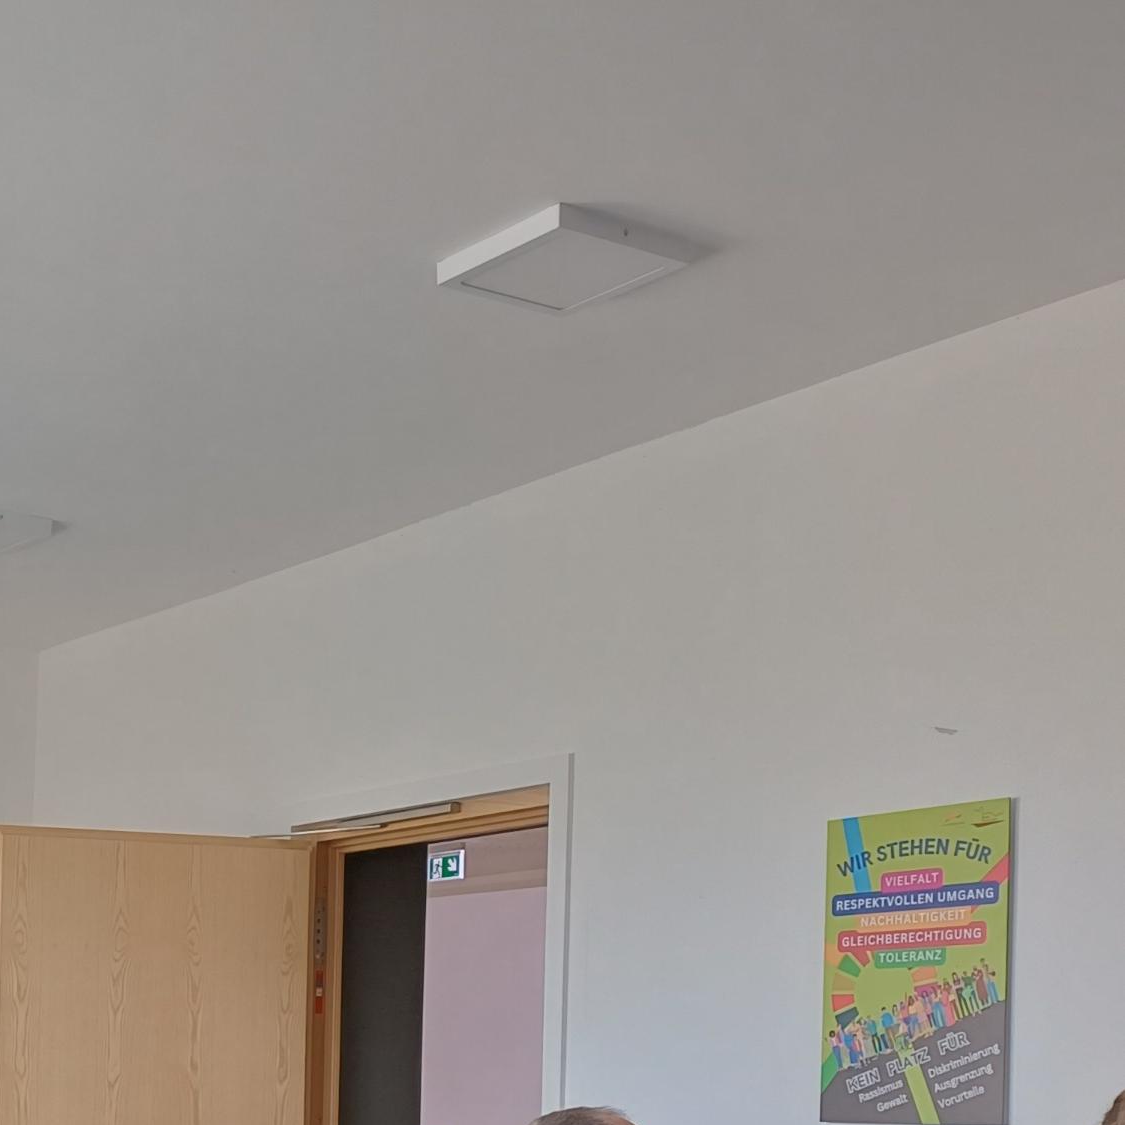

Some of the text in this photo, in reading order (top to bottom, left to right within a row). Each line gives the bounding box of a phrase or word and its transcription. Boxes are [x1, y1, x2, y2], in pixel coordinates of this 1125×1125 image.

[837, 838, 992, 877] WIR STEHEN FÜR
[885, 872, 940, 888] VIELFALT
[836, 887, 994, 911] RESPEKTVOLLEN UMGANG
[860, 909, 966, 927] NACHHALTIGKEIT
[841, 928, 982, 947] GLEICHBERECHTIGUNG
[879, 950, 942, 963] TOLERANZ
[846, 1031, 970, 1093] KEIN PLATZ FÜR
[927, 1042, 1001, 1079] Diskriminierung
[934, 1062, 994, 1093] Ausgrenzung
[858, 1079, 904, 1103] Rassismus
[876, 1093, 908, 1112] Gewalt
[937, 1085, 985, 1109] Vorurteile
